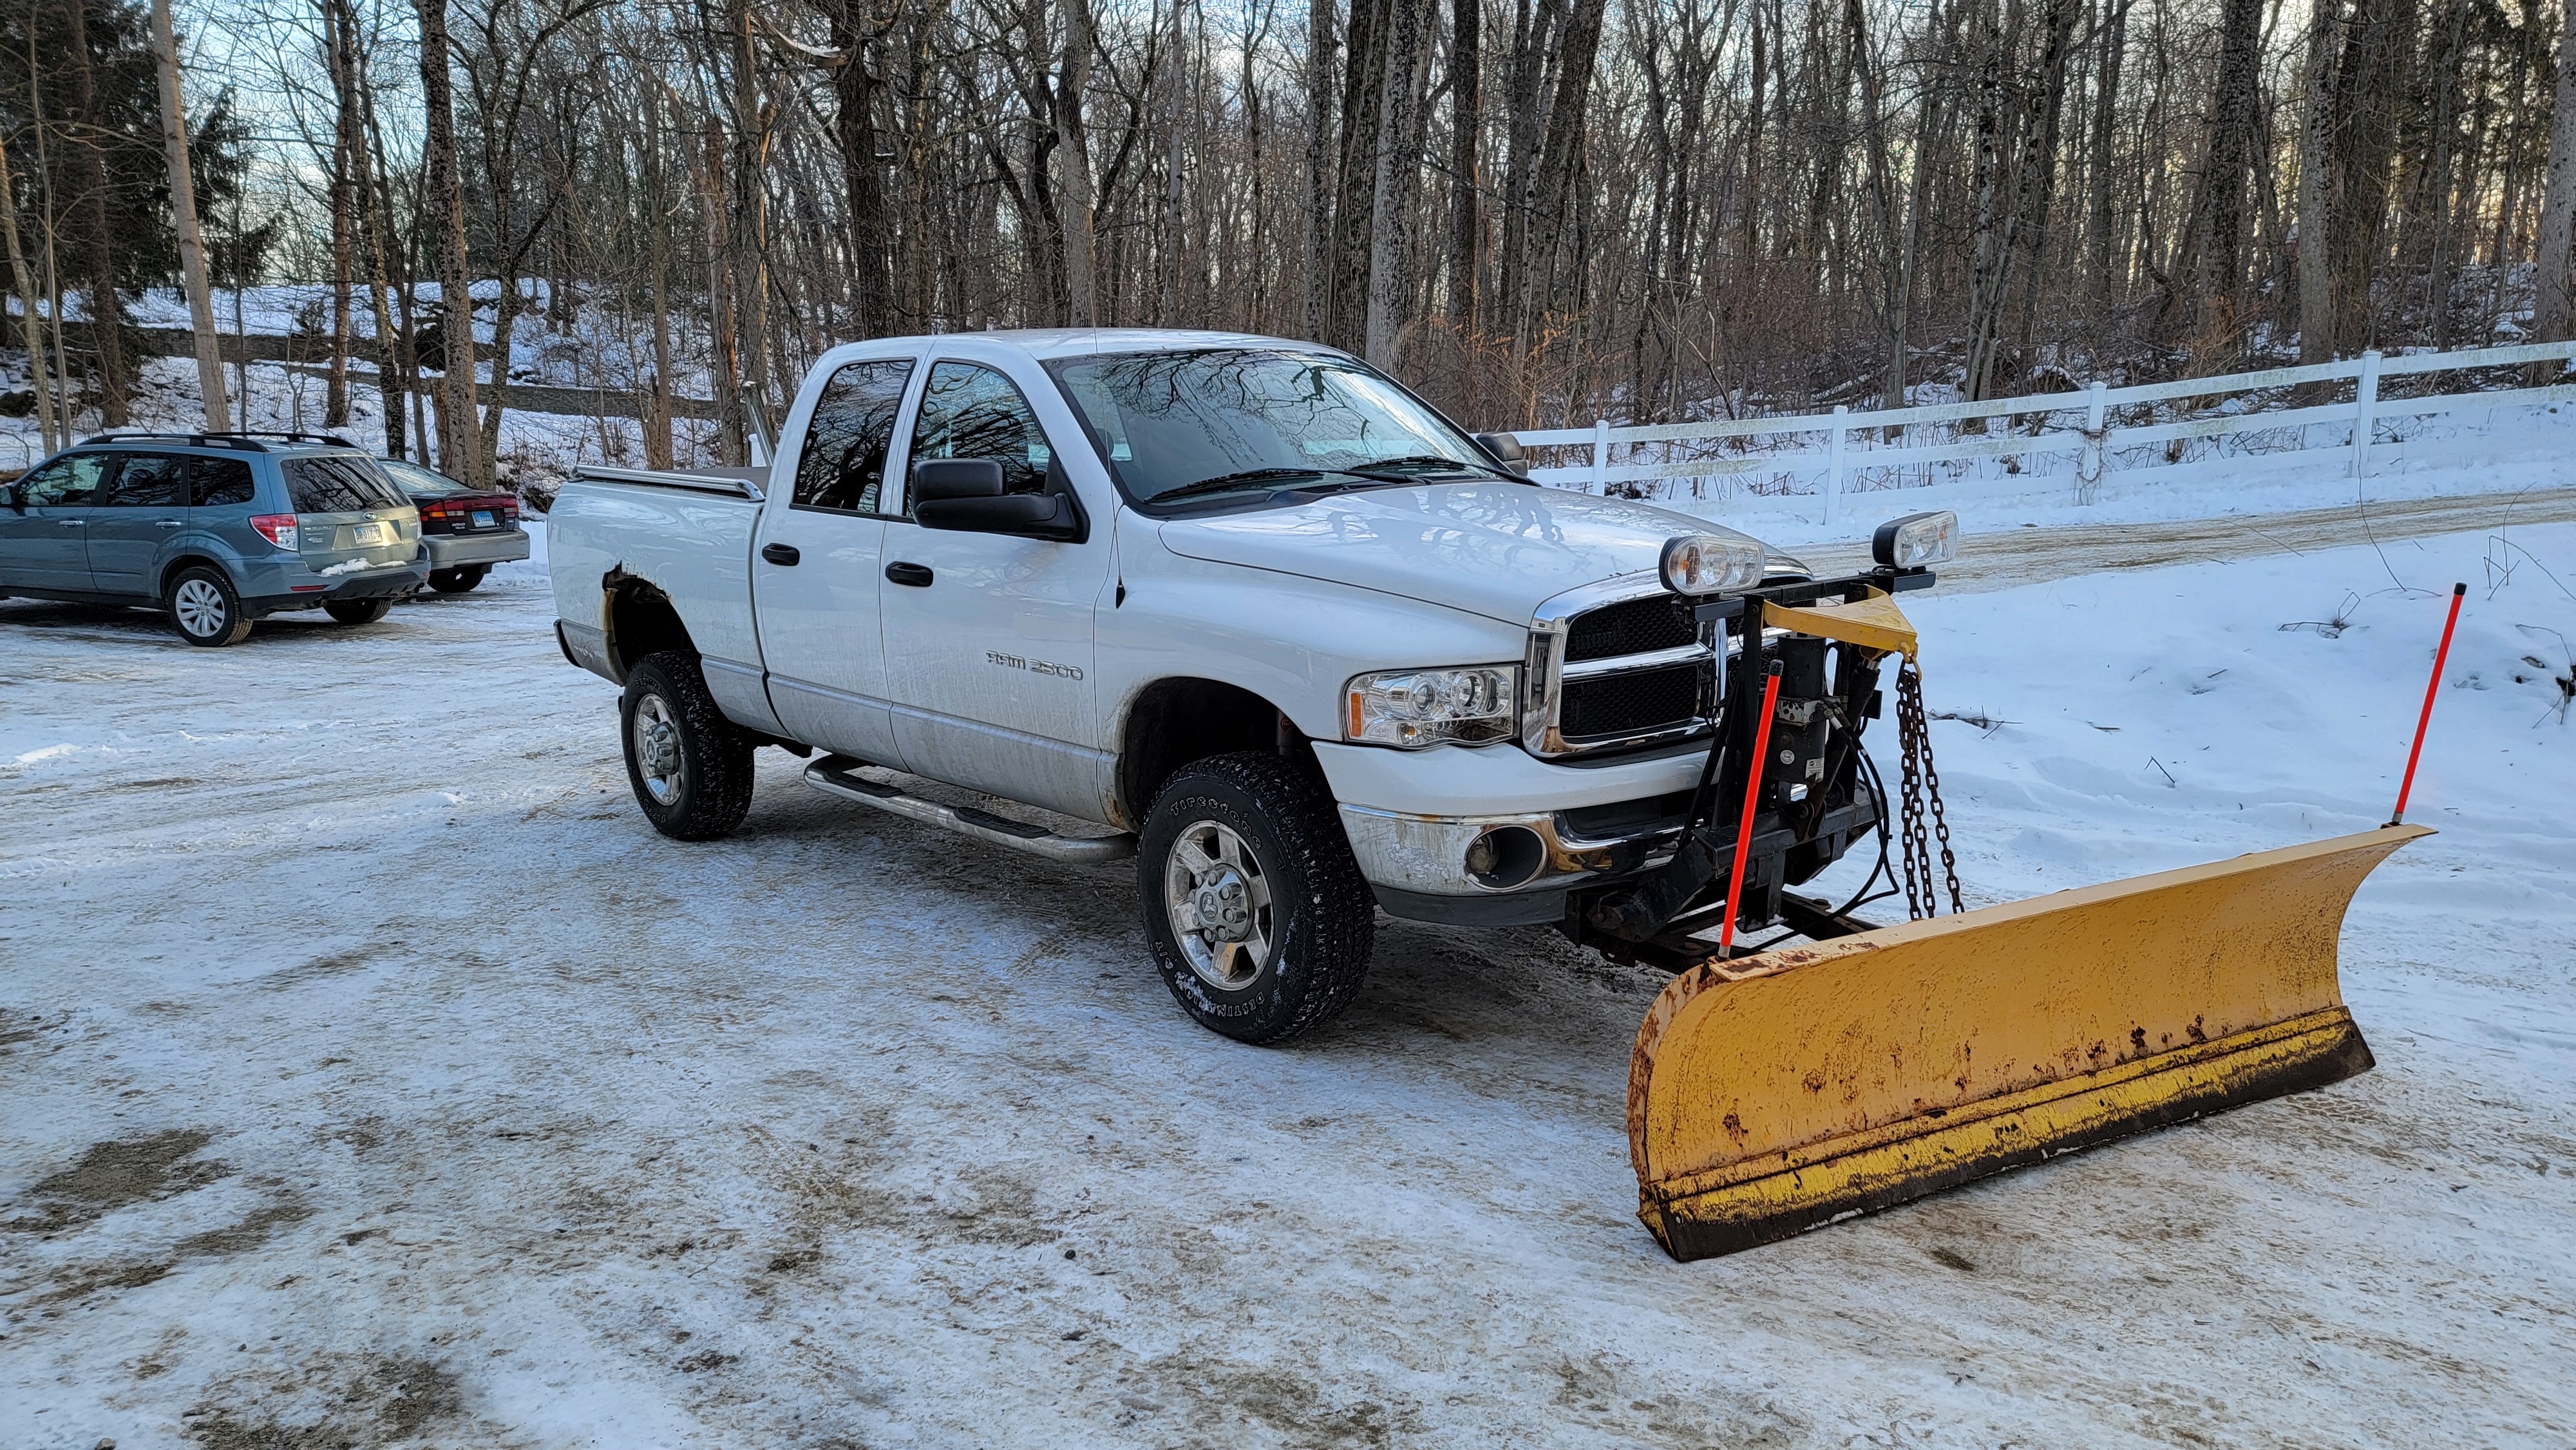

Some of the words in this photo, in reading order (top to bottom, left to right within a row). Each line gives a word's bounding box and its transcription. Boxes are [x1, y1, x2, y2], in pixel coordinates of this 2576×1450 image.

[985, 650, 1026, 670] RAM
[1029, 658, 1083, 681] 2500
[1170, 796, 1262, 850] Firestone
